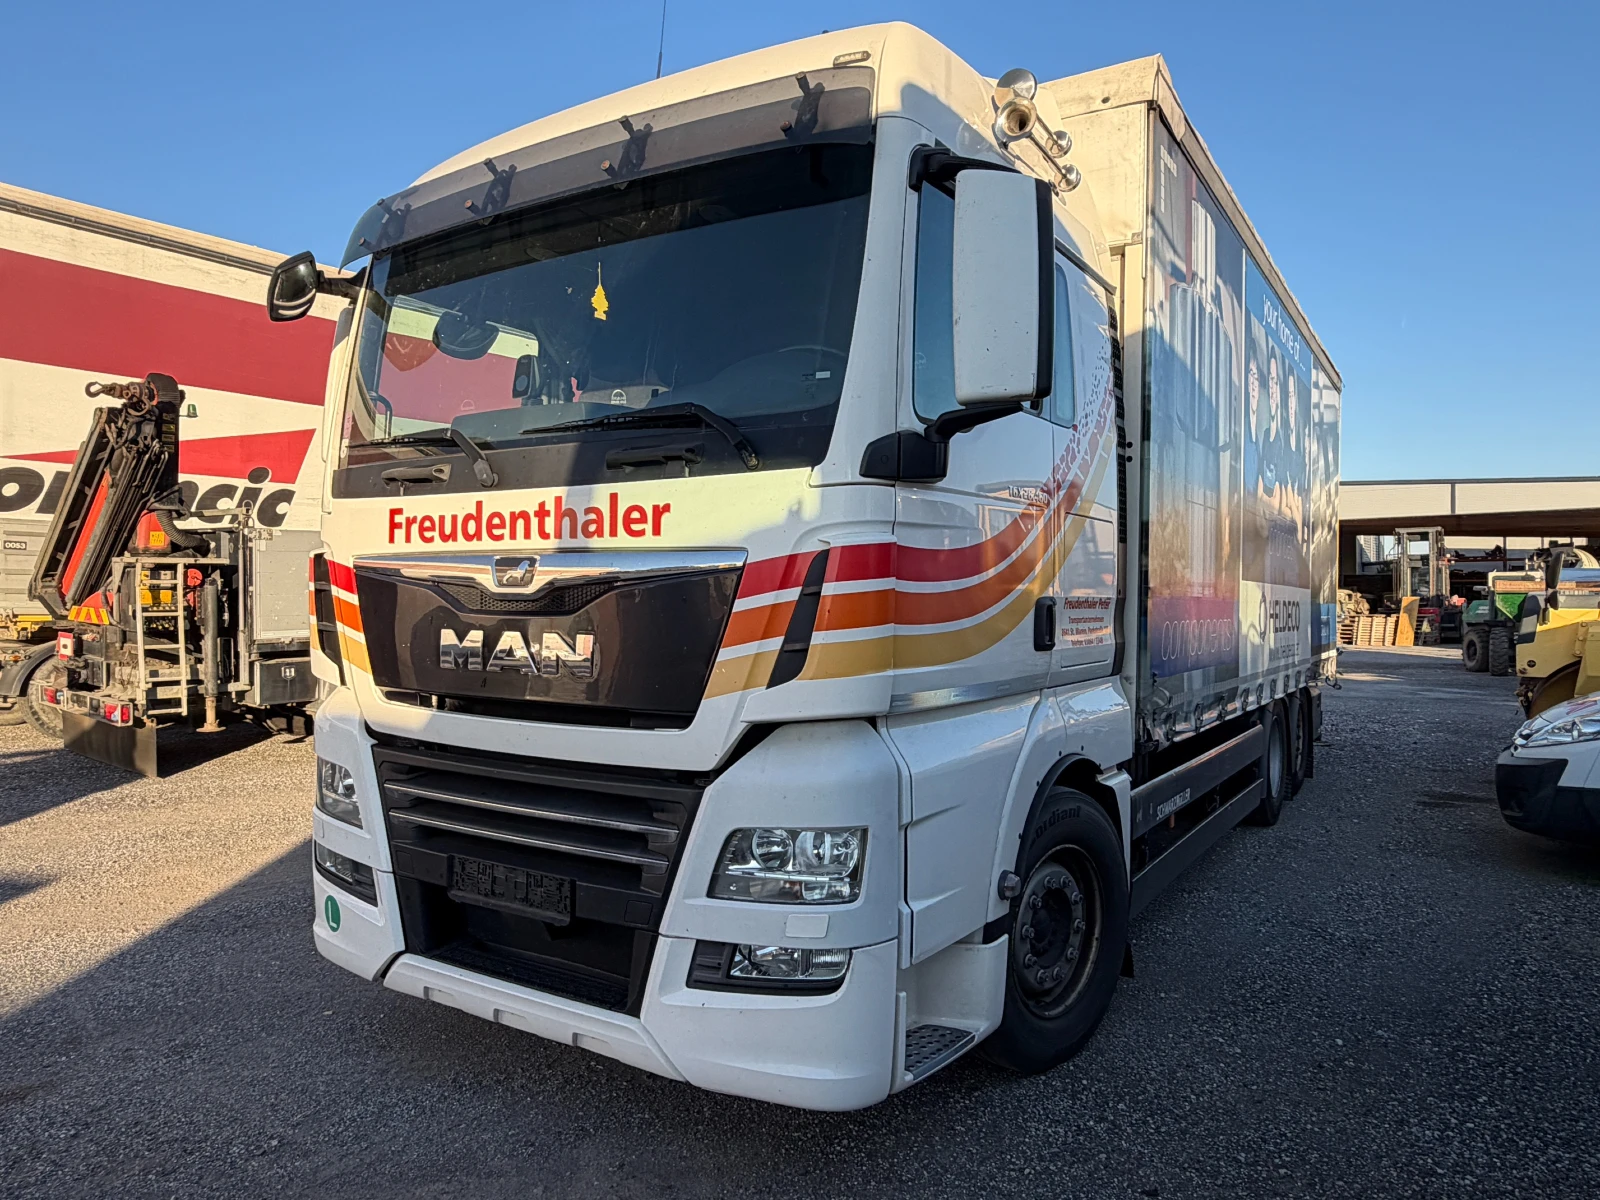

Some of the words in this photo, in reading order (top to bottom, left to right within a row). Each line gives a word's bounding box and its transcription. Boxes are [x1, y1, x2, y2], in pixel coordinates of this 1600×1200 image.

[1262, 294, 1278, 330] your
[1278, 305, 1293, 354] home
[1294, 334, 1301, 363] of
[388, 492, 671, 544] Freudenthaler
[1063, 597, 1098, 609] Freudenthaler
[1098, 597, 1111, 609] Peter
[1268, 600, 1300, 633] HELDECO
[439, 628, 597, 679] MAN
[328, 900, 338, 928] L
